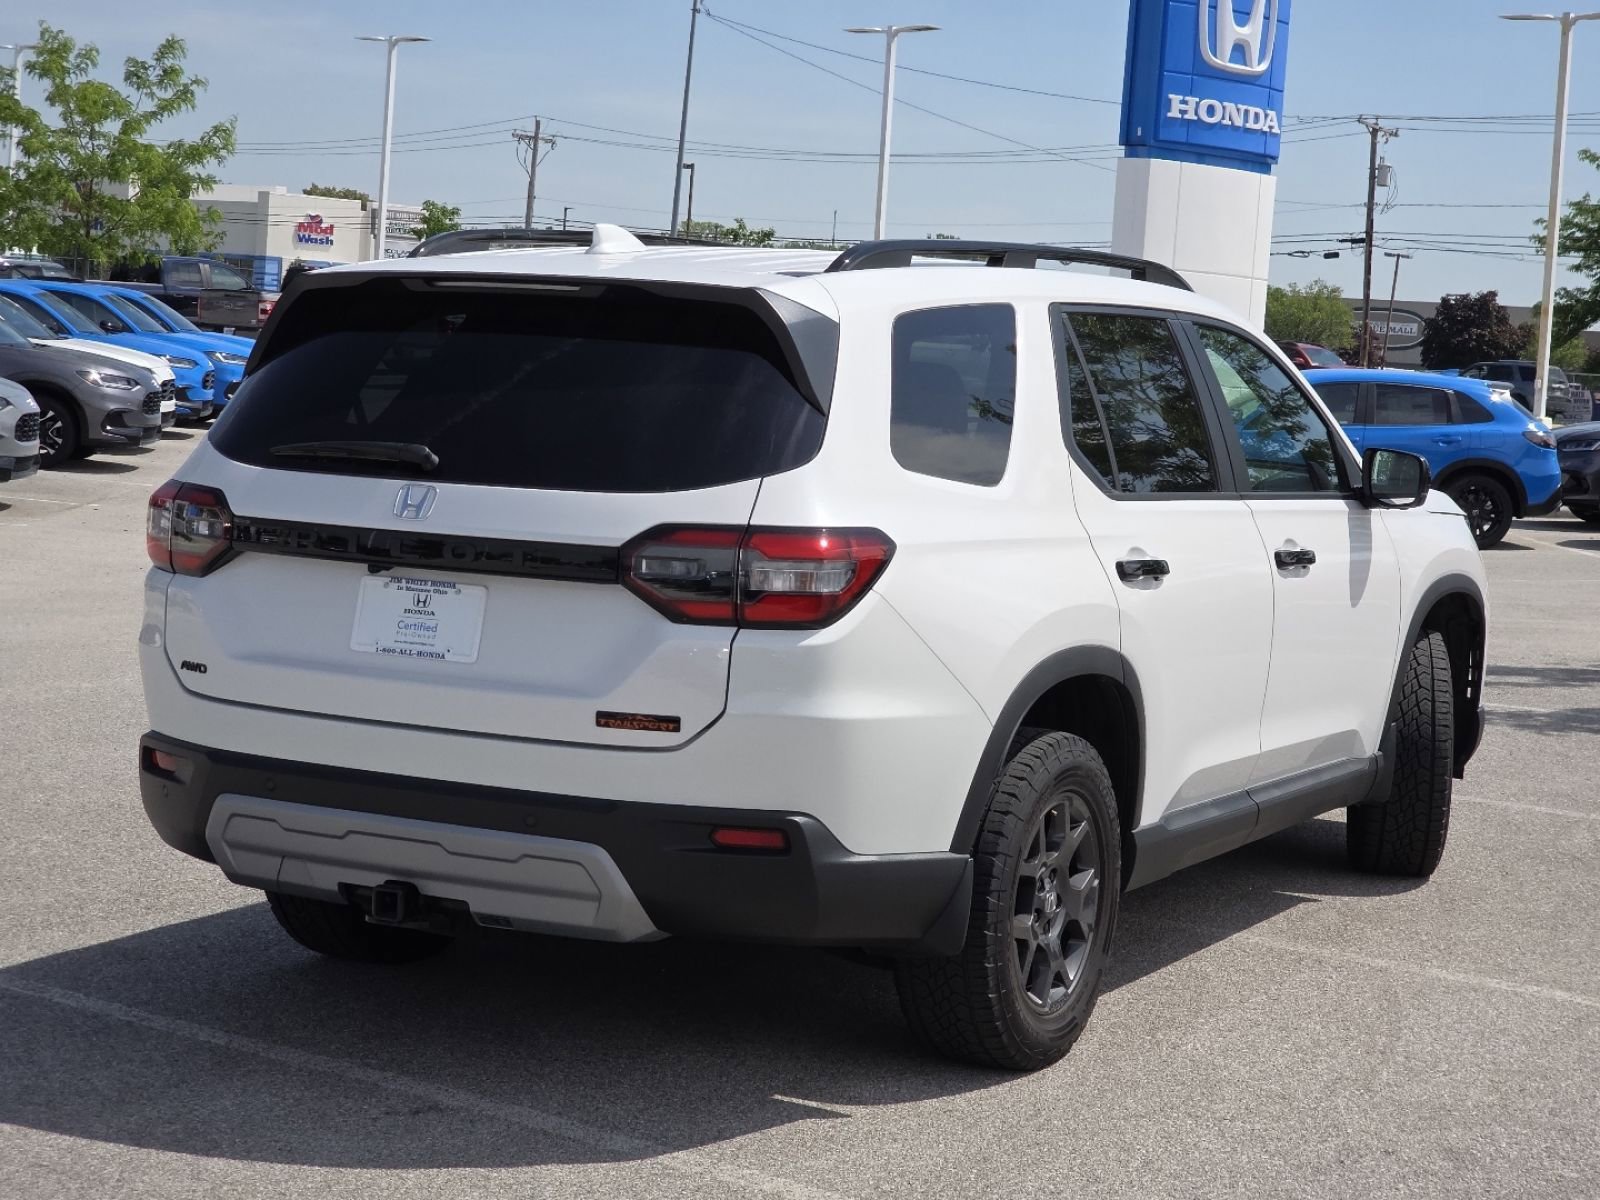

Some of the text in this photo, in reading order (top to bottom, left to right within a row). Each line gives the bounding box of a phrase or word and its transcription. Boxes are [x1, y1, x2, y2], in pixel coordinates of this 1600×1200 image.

[1167, 94, 1280, 134] HONDA
[297, 220, 334, 236] Mod
[297, 233, 334, 246] Wash
[1389, 326, 1416, 335] MALL
[405, 578, 428, 587] WHITE
[430, 580, 456, 589] HONDA
[403, 608, 435, 616] HONDA
[398, 620, 438, 633] Certified
[375, 647, 446, 659] 1-800-ALL-HONDA
[181, 660, 207, 674] AWD
